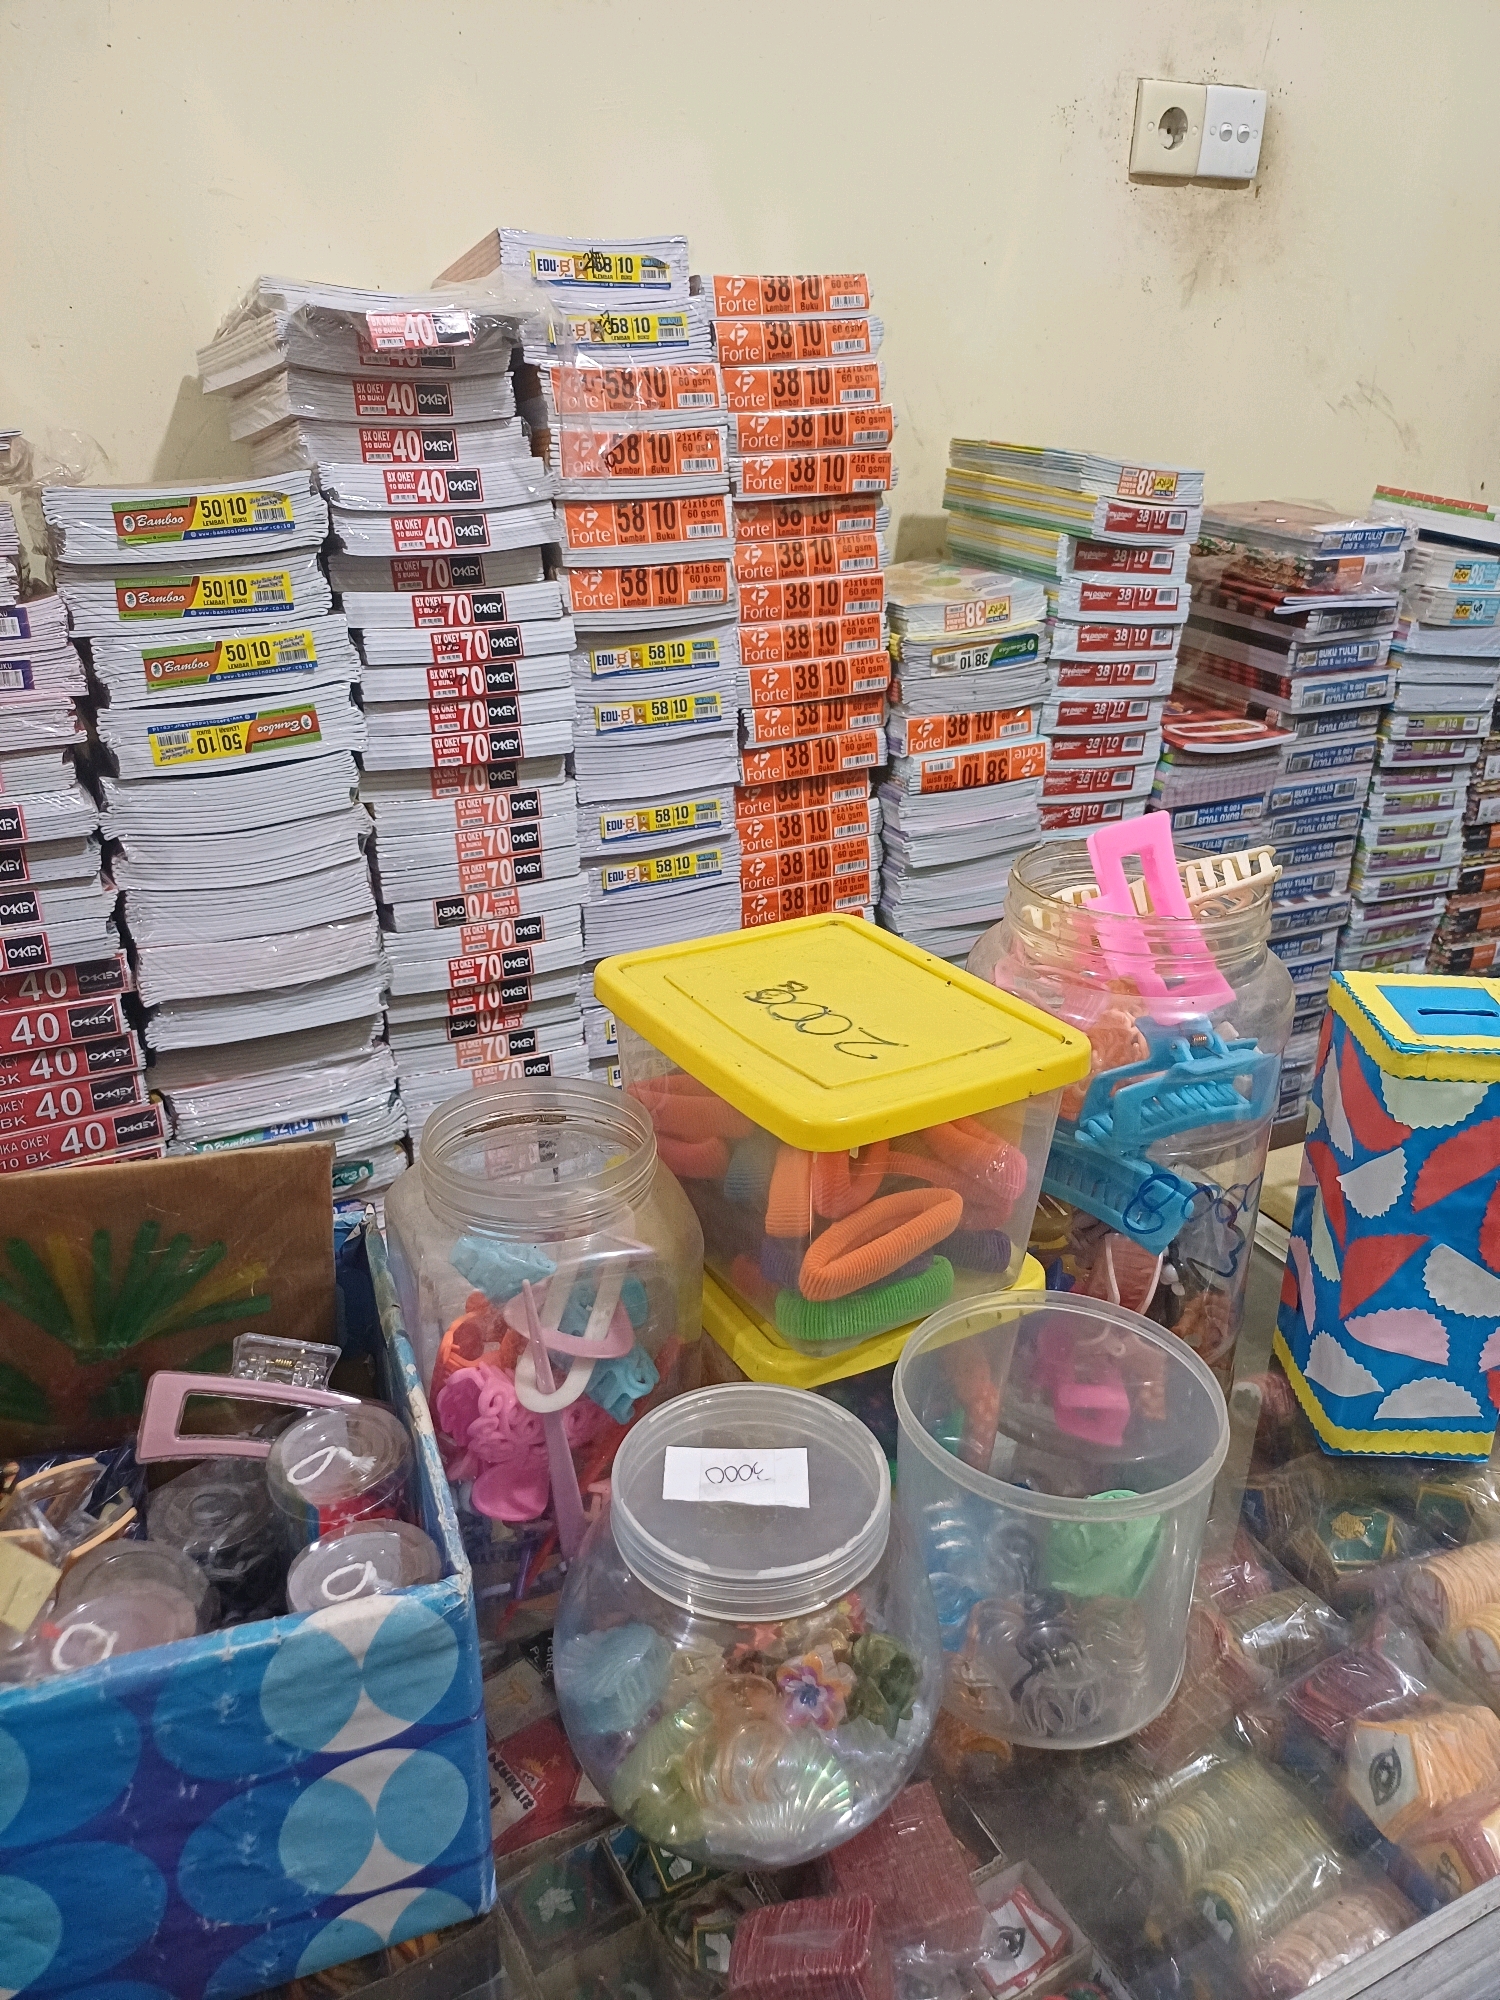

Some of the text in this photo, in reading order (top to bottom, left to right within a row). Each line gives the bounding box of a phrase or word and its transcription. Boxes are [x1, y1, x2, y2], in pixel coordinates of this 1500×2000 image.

[618, 257, 633, 273] 10
[764, 276, 819, 302] 38 10
[719, 297, 757, 312] Forte
[801, 302, 818, 310] Buku
[404, 314, 434, 347] 40
[611, 317, 650, 333] 58 10
[767, 321, 821, 350] 38 10
[722, 346, 759, 362] Forte
[357, 384, 384, 393] BX OKEY
[773, 368, 830, 397] 38 10
[387, 383, 415, 415] 40
[727, 392, 765, 408] Forte
[787, 412, 843, 438] 38 10
[393, 431, 421, 461] 40
[647, 433, 671, 463] 10
[742, 433, 779, 448] Forte
[387, 472, 414, 482] BX OKEY
[790, 455, 845, 482] 38 10
[417, 471, 444, 502] 40
[746, 475, 782, 490] Forte
[824, 483, 841, 492] Buku
[201, 499, 222, 518] 50
[227, 497, 247, 516] 10
[136, 513, 184, 527] Bamboo
[203, 519, 225, 527] LEMBAR
[617, 502, 675, 532] 58 10
[1137, 510, 1166, 524] 38 10
[424, 517, 451, 549] 40
[572, 530, 675, 544] Forte Lembar Buku
[203, 580, 223, 598] 50
[228, 579, 247, 597] 10
[621, 566, 678, 596] 58 10
[138, 591, 185, 604] Bamboo
[575, 591, 613, 606] Forte
[658, 596, 677, 605] Buku
[785, 580, 838, 610] 38 10
[1118, 588, 1152, 600] 38 10
[442, 595, 470, 625] 70
[743, 605, 779, 619] Forte
[1114, 629, 1147, 641] 38 10
[225, 644, 247, 662] 50
[251, 641, 271, 658] 10
[460, 630, 488, 661] 70
[649, 644, 685, 660] 58 10
[163, 658, 210, 673] Bamboo
[960, 652, 989, 670] 38 10
[1096, 664, 1130, 676] 38 10
[795, 660, 846, 690] 38 10
[755, 687, 789, 701] Forte
[257, 721, 300, 735] Bamboo
[947, 712, 993, 738] 38 10
[197, 738, 217, 754] 10
[222, 734, 243, 751] 50
[461, 733, 488, 764] 70
[910, 737, 941, 752] Forte
[786, 738, 836, 768] 38 10
[1014, 746, 1043, 759] Forte
[747, 766, 780, 782] Forte
[962, 760, 1008, 786] 38 10
[483, 795, 509, 823] 70
[655, 806, 689, 823] 58 10
[656, 857, 690, 874] 58 10
[780, 846, 829, 876] 38 10
[743, 875, 774, 890] Forte
[468, 894, 493, 919] 70
[19, 968, 67, 1001] 40
[30, 1047, 78, 1080] 40
[36, 1087, 82, 1120] 40
[21, 1135, 50, 1150] OKEY
[61, 1123, 107, 1154] 40
[1, 1151, 53, 1170] 10 BK
